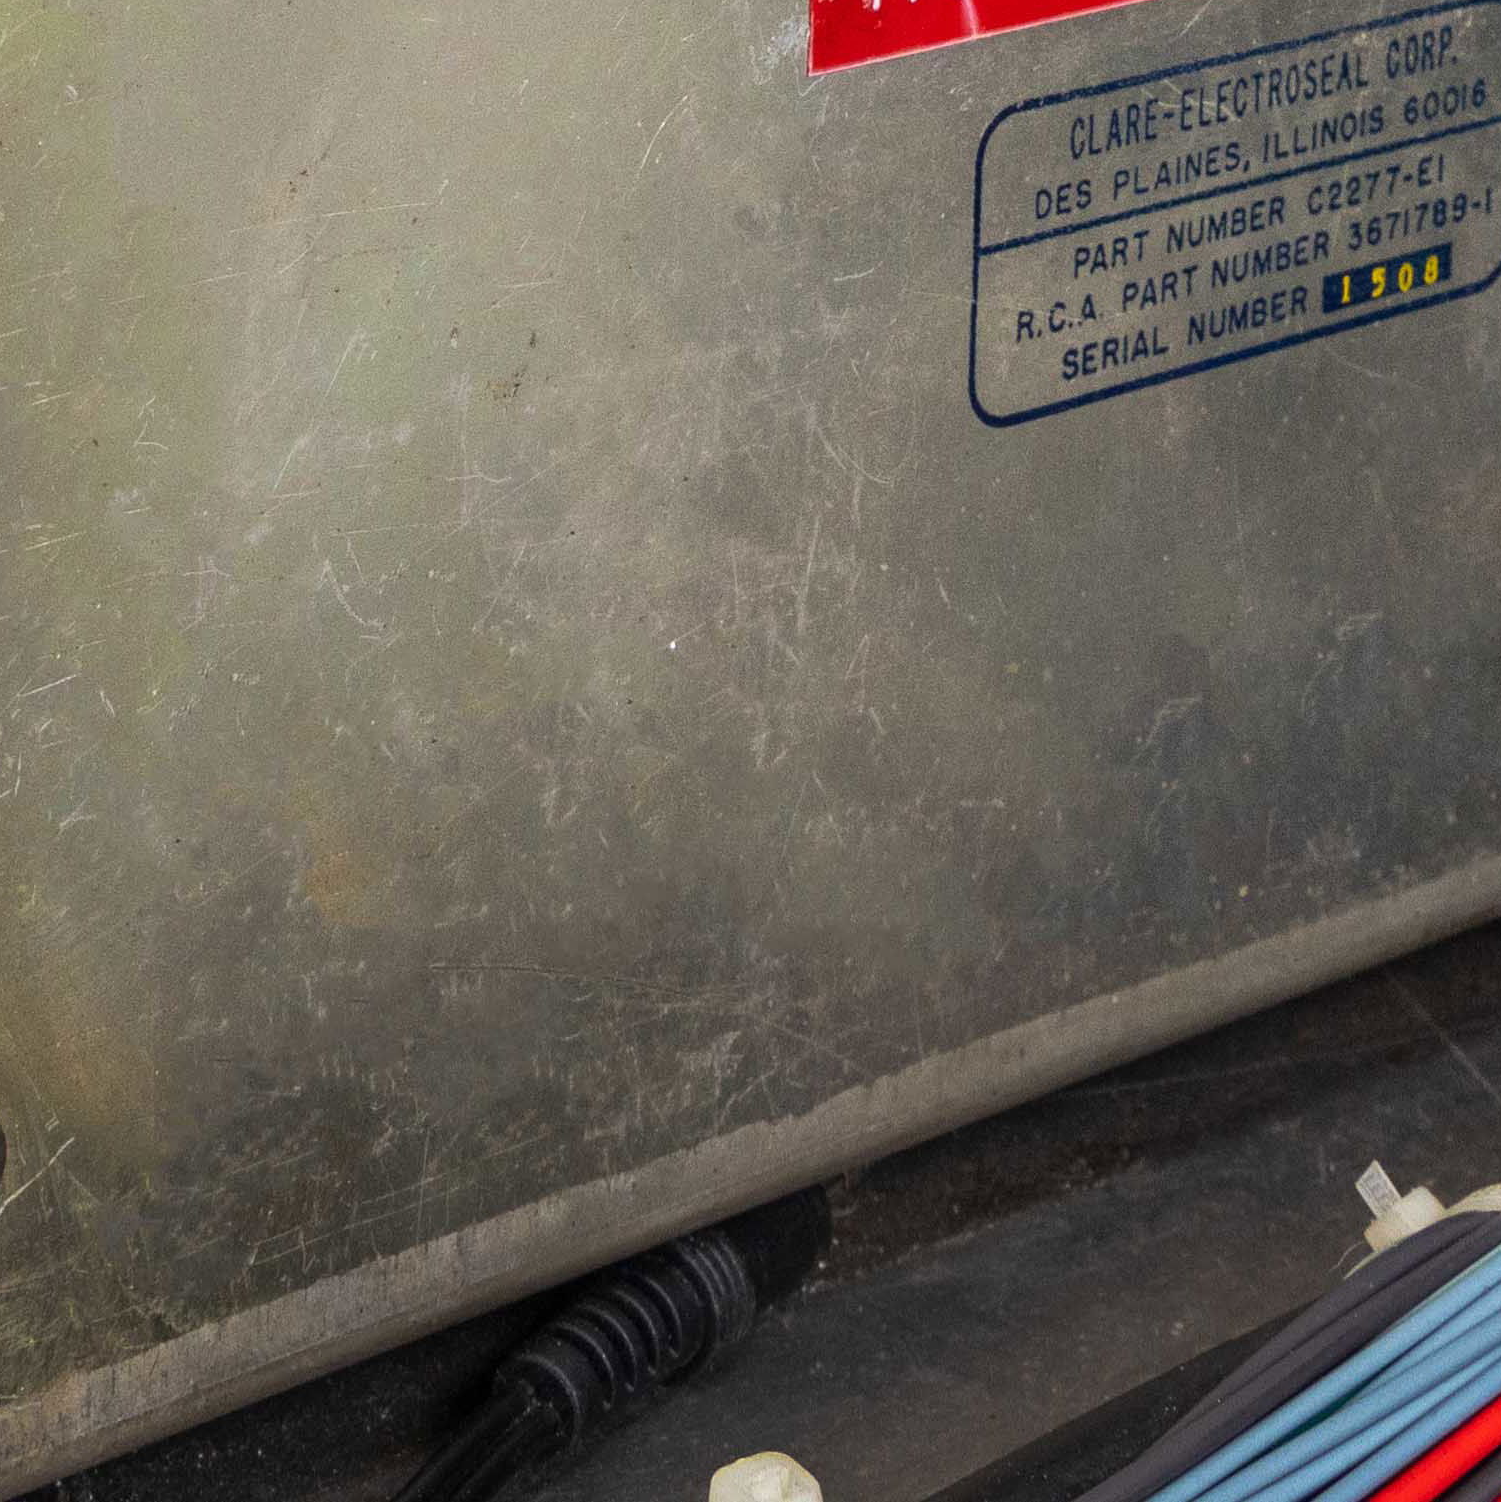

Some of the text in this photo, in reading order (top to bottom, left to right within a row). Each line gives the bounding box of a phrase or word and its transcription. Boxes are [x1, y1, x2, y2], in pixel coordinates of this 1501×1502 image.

[1035, 77, 1486, 220] DES PLAINES, ILLINOIS 60016
[1069, 25, 1459, 161] CLARE-ELECTROSEAL CORP.
[1074, 153, 1444, 279] PART NUMBER C2277-E1
[1122, 265, 1198, 311] PART
[1211, 230, 1330, 288] NUMBER
[1348, 188, 1493, 251] 3671789-1
[1061, 255, 1440, 381] SERIAL NUMBER 1508
